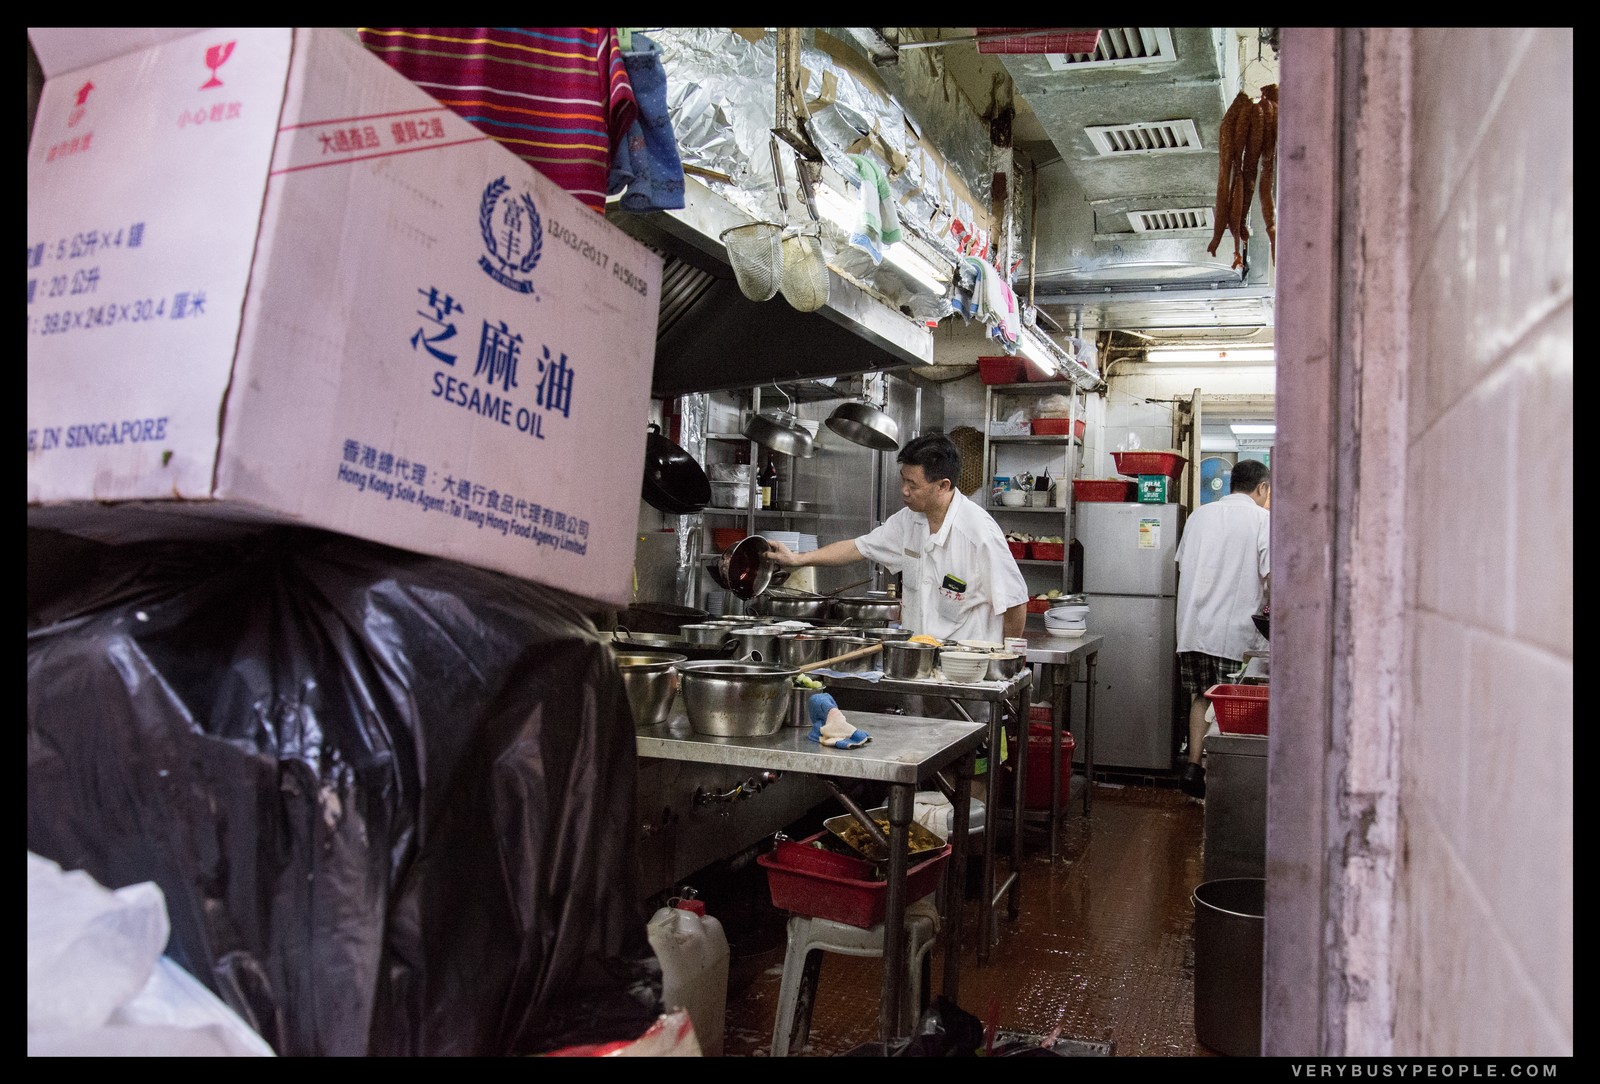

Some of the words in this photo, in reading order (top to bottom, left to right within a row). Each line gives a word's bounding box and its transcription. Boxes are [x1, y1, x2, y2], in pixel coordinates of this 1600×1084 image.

[410, 286, 575, 419] 芝麻油
[42, 427, 61, 450] IN
[65, 417, 168, 449] SINGAPORE
[431, 371, 512, 426] SESAME
[516, 408, 545, 440] OIL
[338, 463, 366, 491] Hong
[368, 473, 394, 500] Kong
[395, 482, 416, 503] Sole
[450, 499, 462, 518] Tai
[463, 504, 485, 529] Tung
[486, 512, 509, 536] Hong
[510, 519, 531, 538] Food
[531, 526, 560, 550] Agency
[560, 535, 588, 556] Limited
